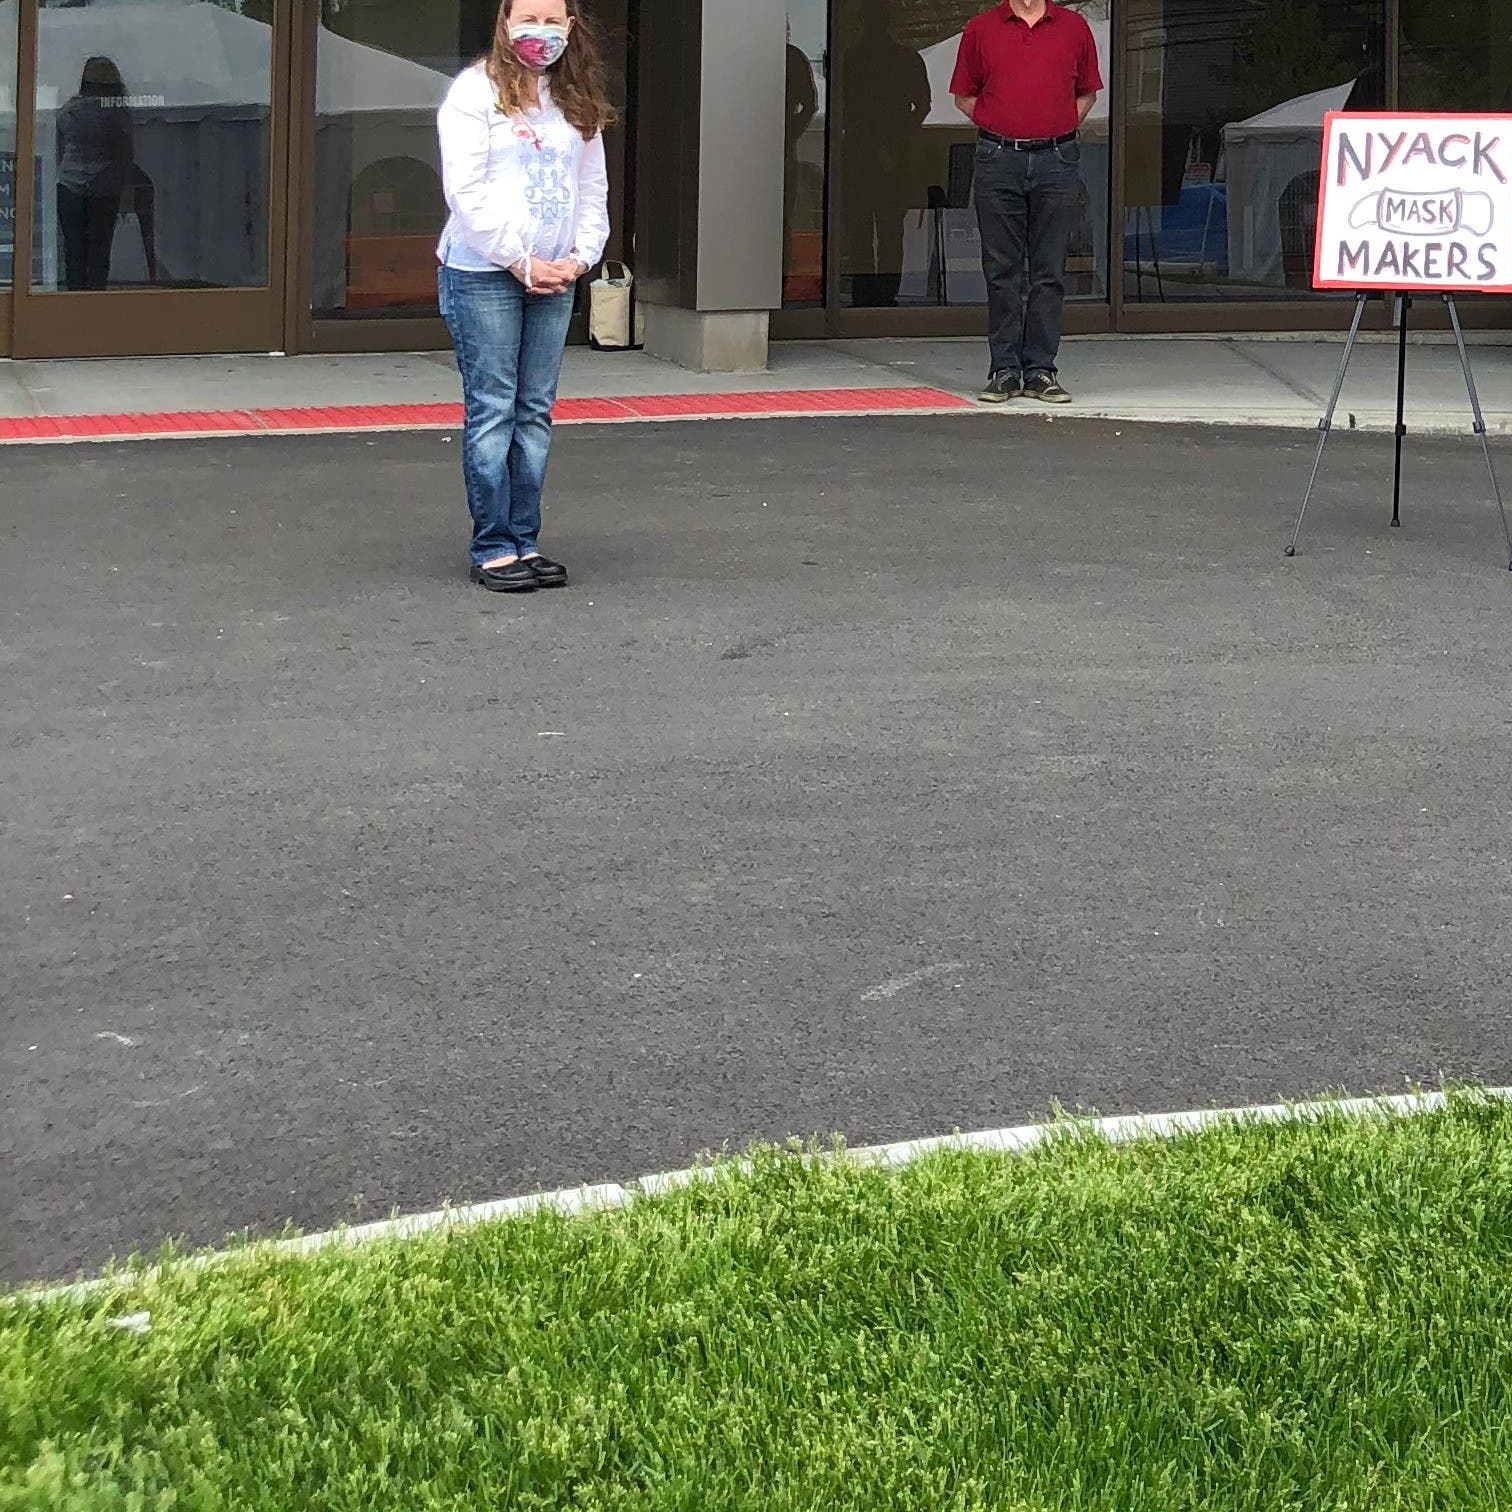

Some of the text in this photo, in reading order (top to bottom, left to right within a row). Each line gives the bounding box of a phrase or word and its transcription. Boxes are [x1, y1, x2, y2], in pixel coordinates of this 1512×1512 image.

[100, 95, 165, 108] INFORMATION
[1337, 131, 1507, 187] NYACK
[1385, 197, 1454, 224] MASK
[1336, 239, 1499, 281] MAKERS
